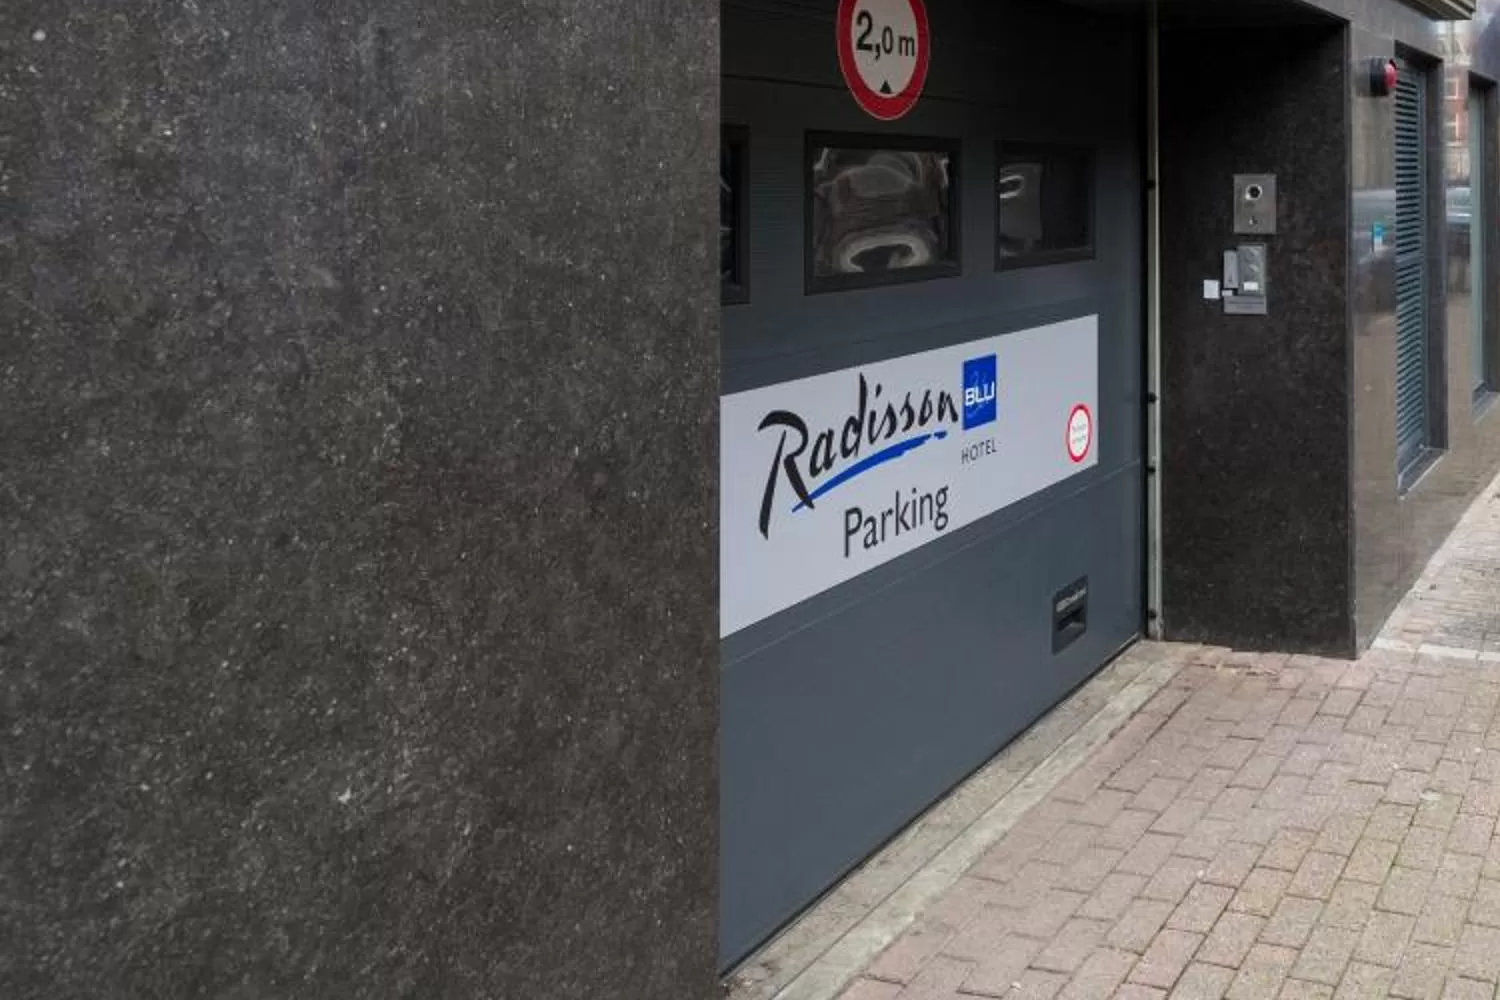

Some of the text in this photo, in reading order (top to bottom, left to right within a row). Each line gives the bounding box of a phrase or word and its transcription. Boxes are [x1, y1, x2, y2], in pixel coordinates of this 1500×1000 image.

[856, 9, 915, 61] 2,0 m
[757, 371, 996, 540] Radisson BLU
[960, 438, 998, 465] HOTEL
[844, 484, 950, 558] Parking
